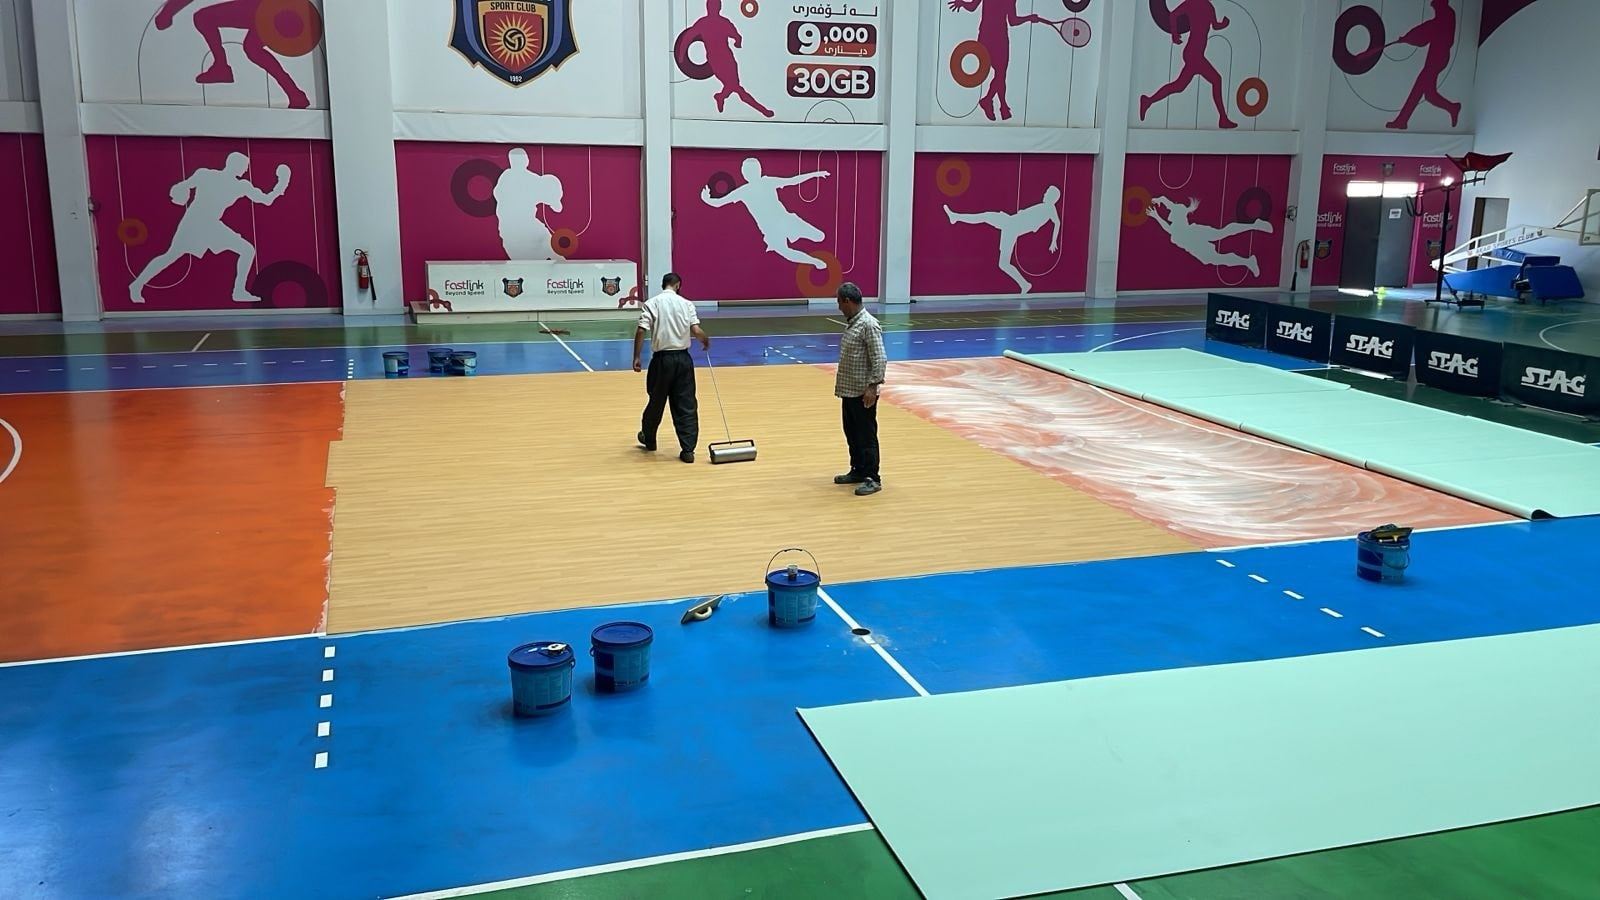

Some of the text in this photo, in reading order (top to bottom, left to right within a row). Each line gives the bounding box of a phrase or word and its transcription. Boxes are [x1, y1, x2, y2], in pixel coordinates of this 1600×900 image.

[490, 2, 537, 13] SPORT CLUB
[797, 23, 869, 55] 9,000
[792, 67, 870, 95] 30GB
[1215, 309, 1250, 330] STAG
[1276, 320, 1314, 344] STAG
[1345, 334, 1395, 359] STAG
[1428, 351, 1479, 378] STAG
[1520, 366, 1586, 397] STAG
